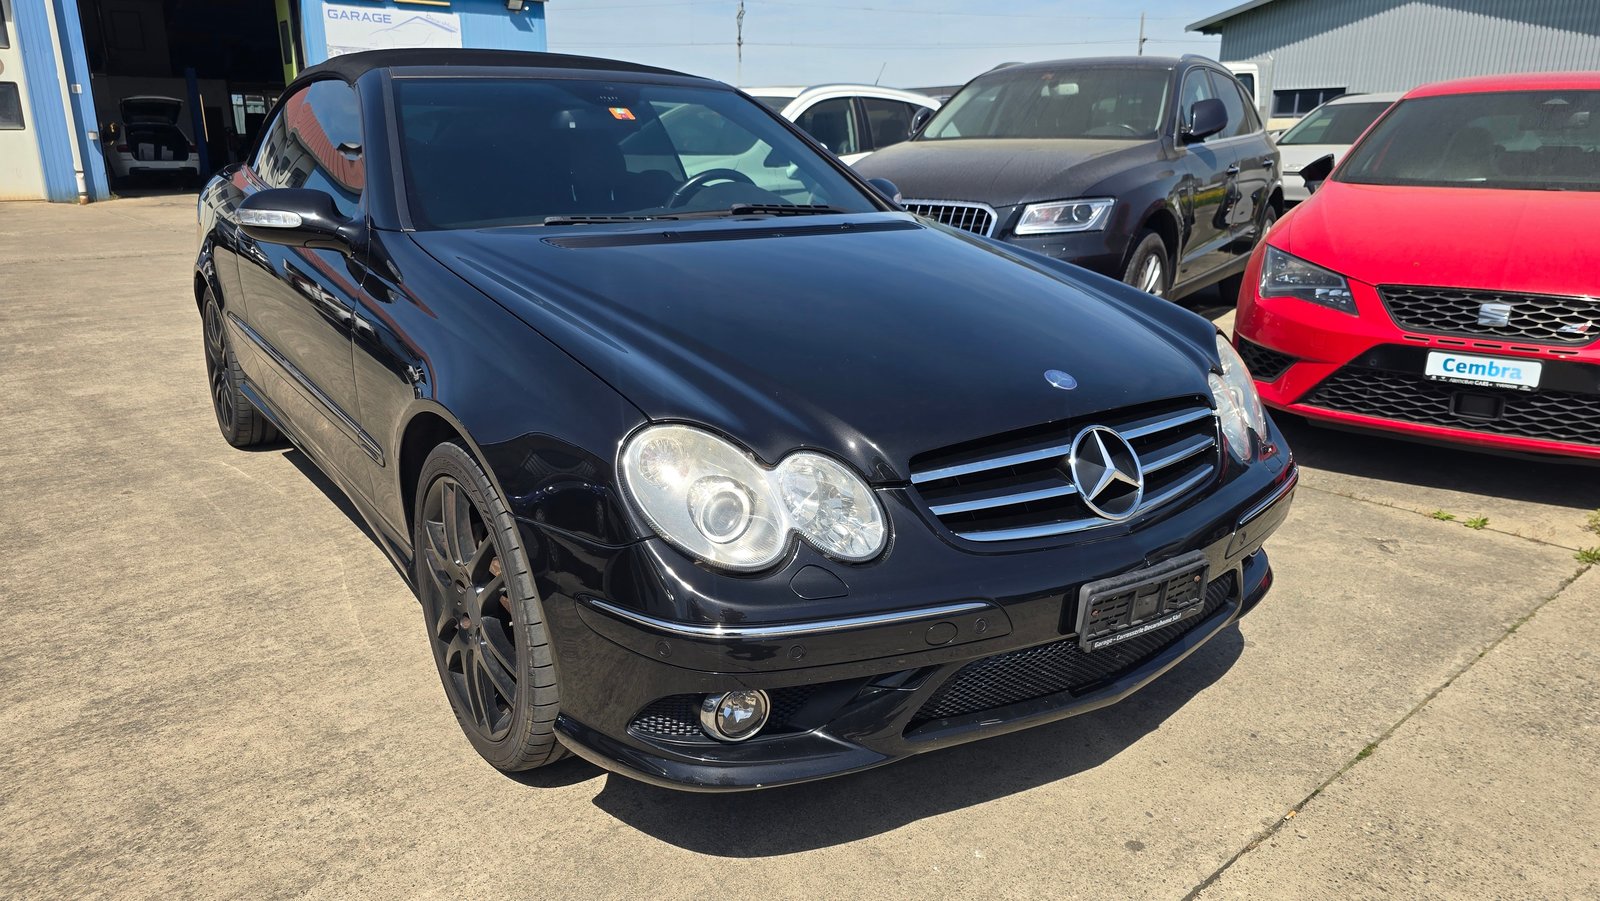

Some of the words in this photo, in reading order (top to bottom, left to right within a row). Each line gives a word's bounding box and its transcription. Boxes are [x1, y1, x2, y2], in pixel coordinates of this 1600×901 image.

[327, 9, 392, 24] GARAGE
[1442, 358, 1522, 380] Cembra
[1094, 639, 1113, 648] Garage
